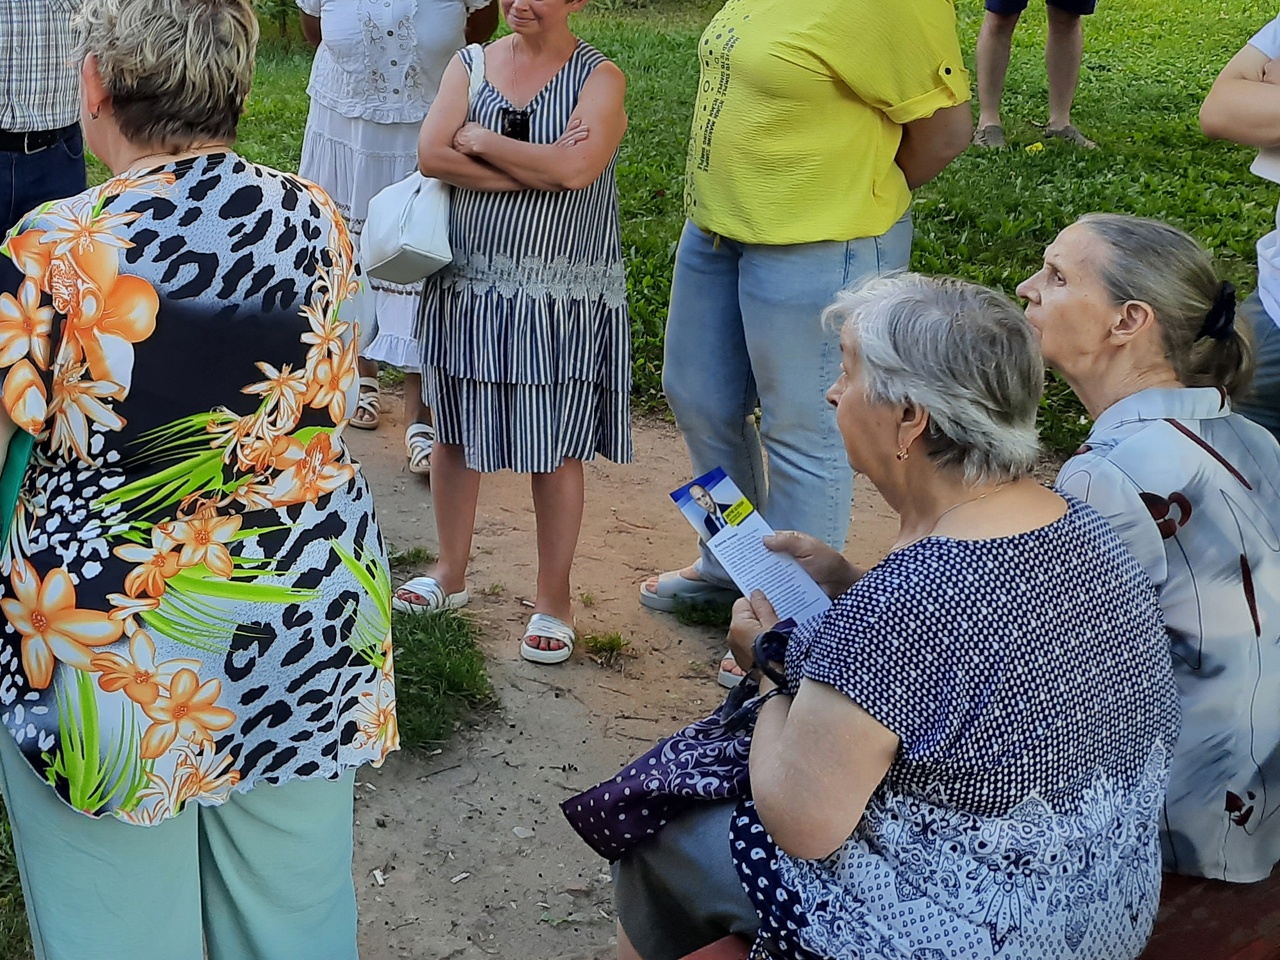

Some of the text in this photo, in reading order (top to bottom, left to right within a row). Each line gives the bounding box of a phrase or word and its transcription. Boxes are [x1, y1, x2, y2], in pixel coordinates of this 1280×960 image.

[722, 34, 735, 51] HARD
[726, 36, 740, 53] HARD
[720, 61, 725, 69] TO
[725, 62, 730, 71] TO
[702, 118, 711, 145] MAKING
[706, 120, 716, 147] MAKING
[697, 147, 706, 170] SIMPLE
[702, 149, 711, 172] SIMPLE
